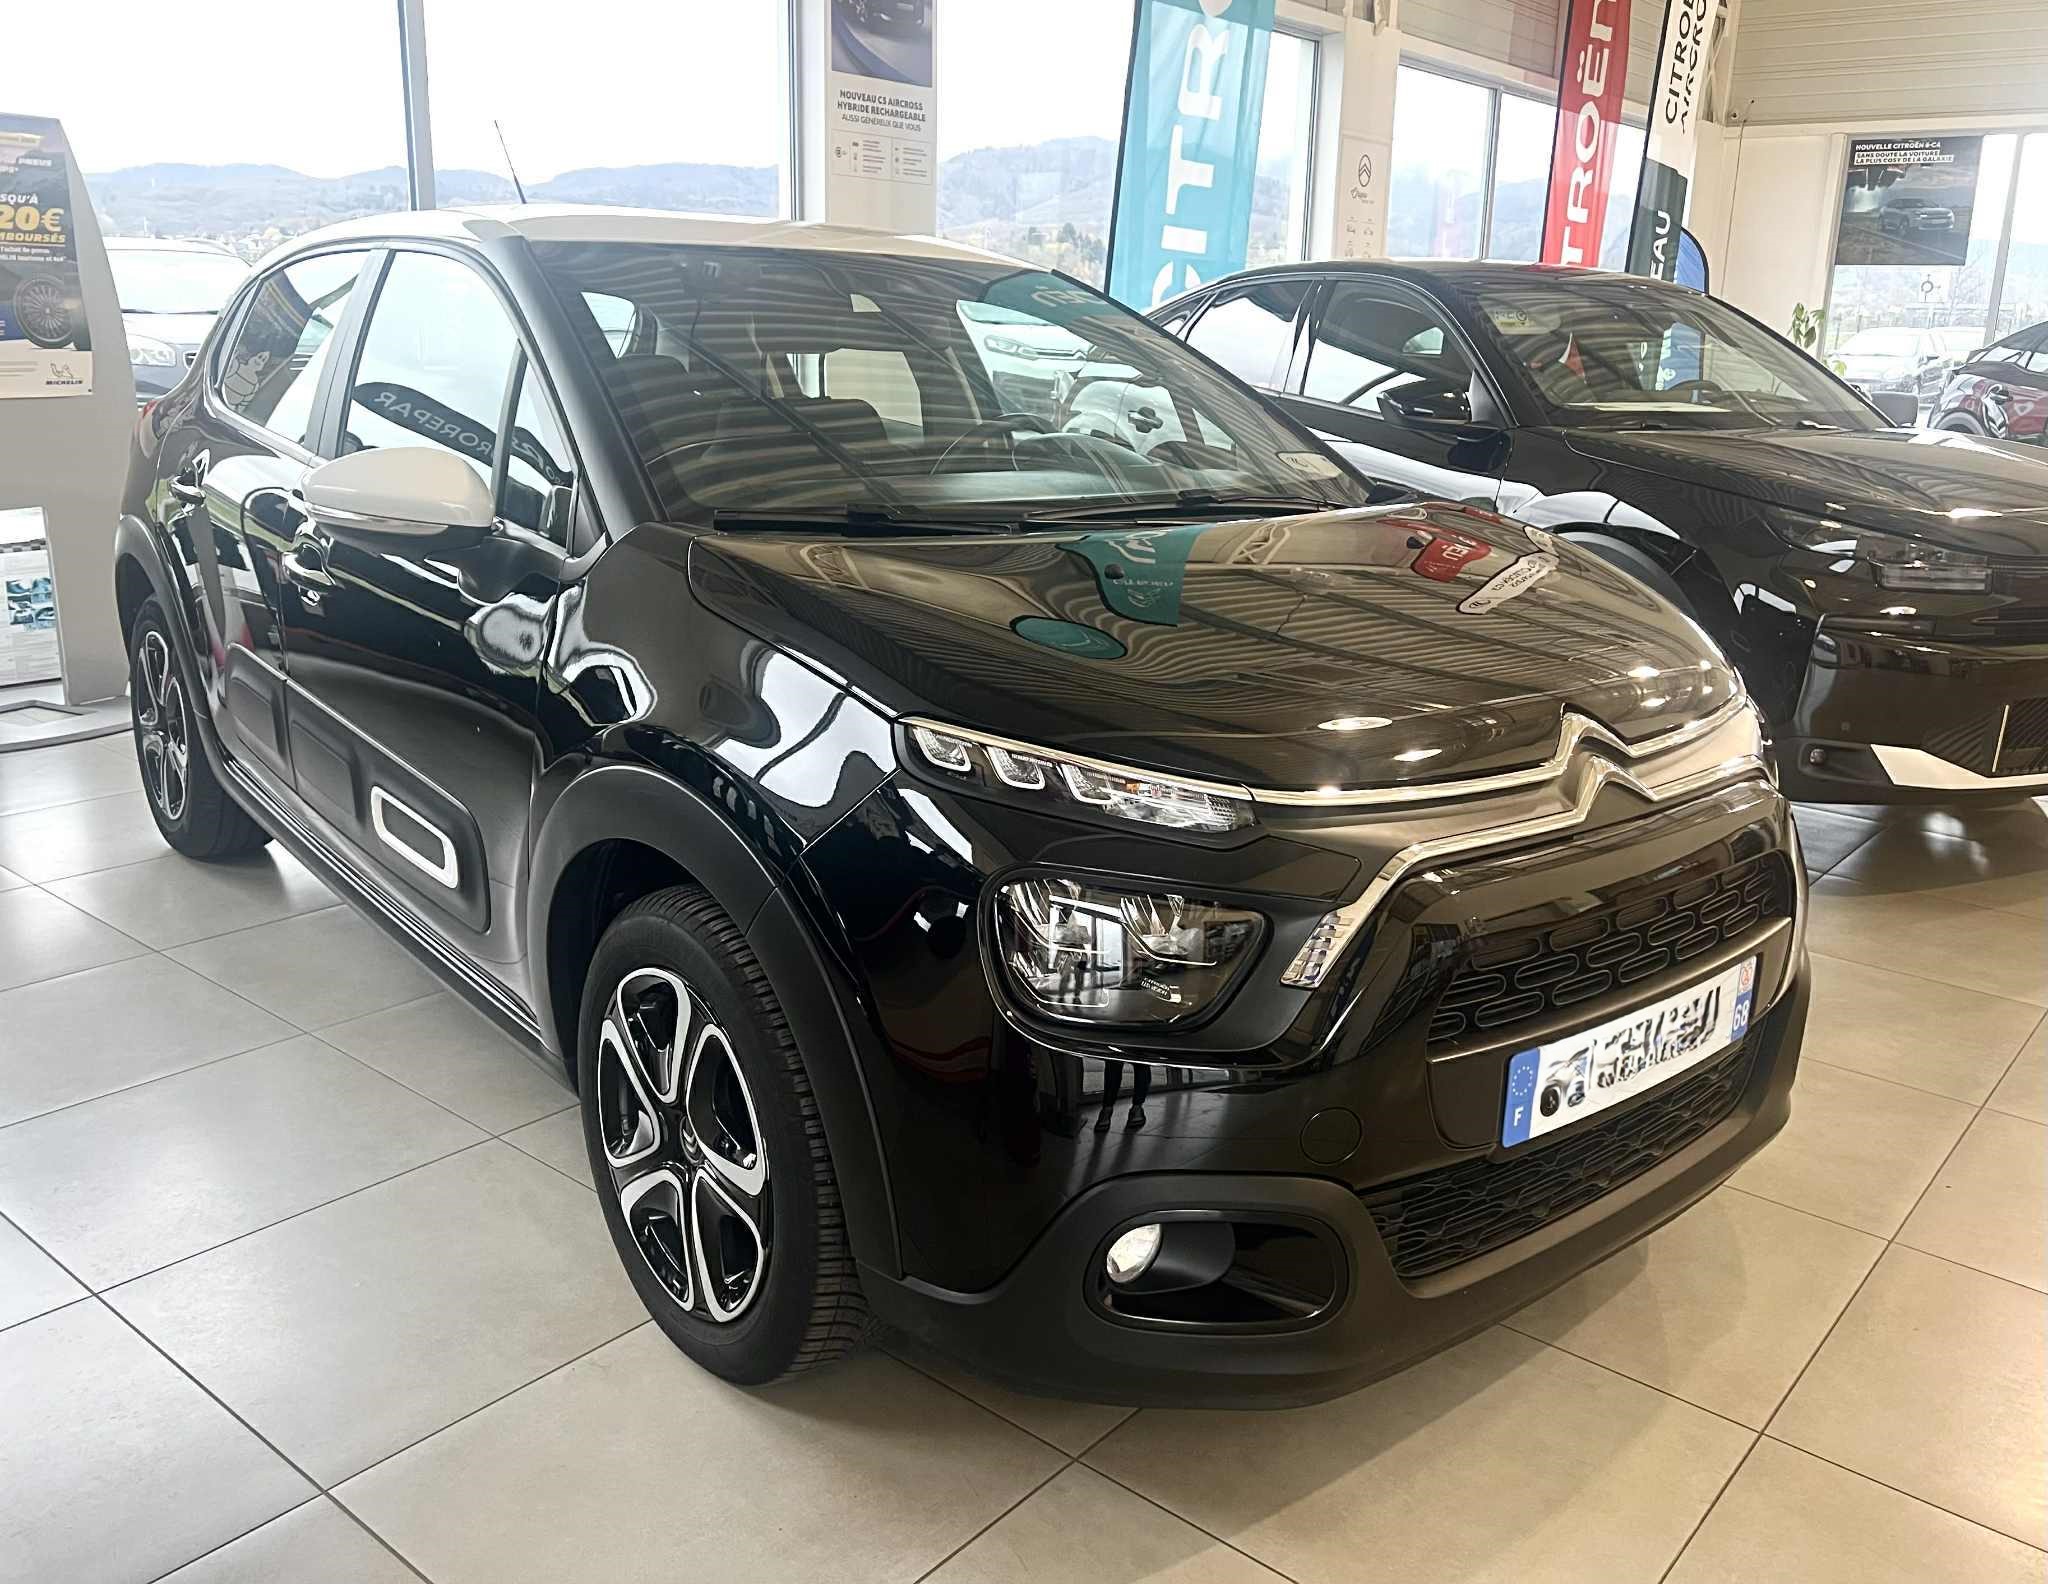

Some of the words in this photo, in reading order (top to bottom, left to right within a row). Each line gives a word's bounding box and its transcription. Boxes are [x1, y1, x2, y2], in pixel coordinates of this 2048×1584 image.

[840, 89, 877, 104] NOUVEAU
[888, 97, 923, 110] AIRCROSS
[837, 100, 869, 113] HYBRIDE
[870, 106, 926, 122] RECHARGEABLE
[1855, 143, 1892, 151] NOUVELLE
[1733, 1000, 1750, 1031] 68
[1513, 1106, 1524, 1126] F
